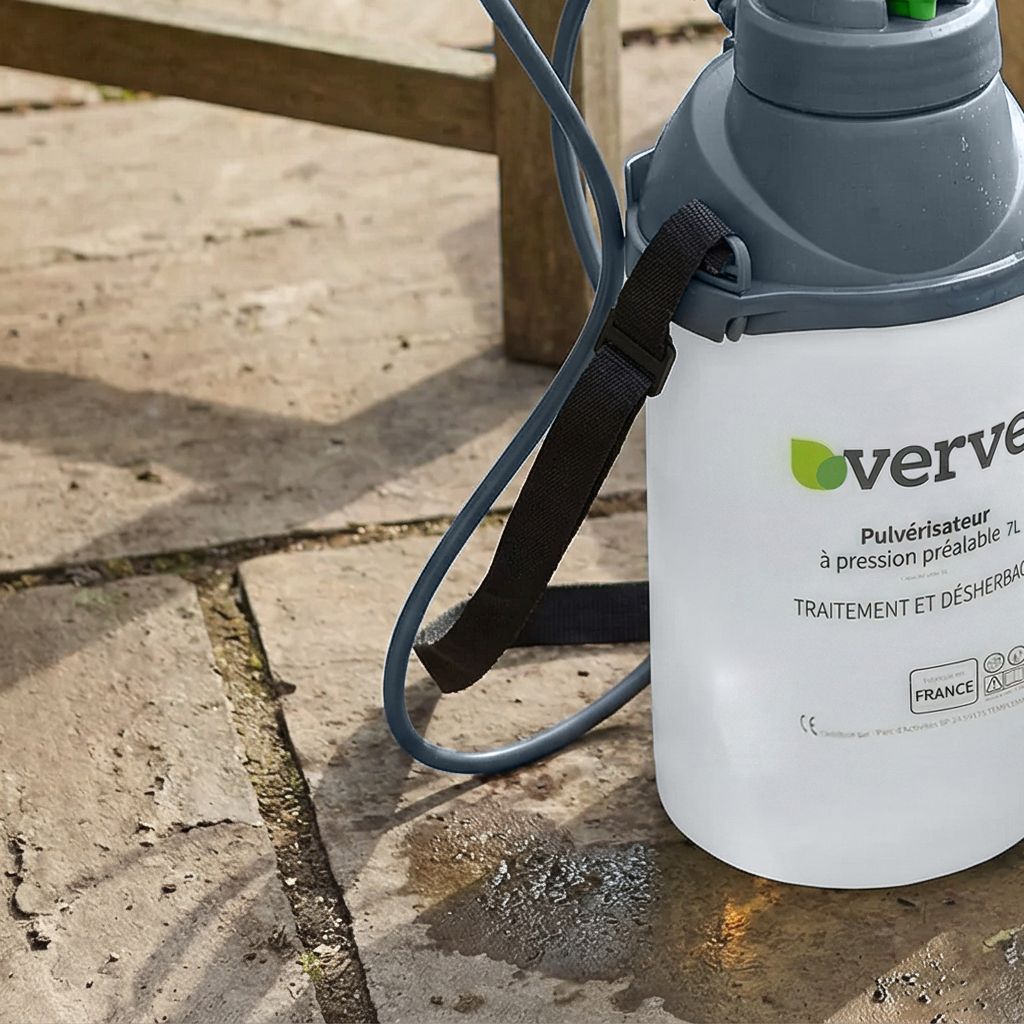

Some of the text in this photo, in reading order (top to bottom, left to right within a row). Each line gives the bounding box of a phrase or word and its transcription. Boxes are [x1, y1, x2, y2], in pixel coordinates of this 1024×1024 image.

[861, 508, 991, 545] Pulvérisateur
[819, 519, 1021, 573] à pression préalable 7L
[793, 597, 910, 620] TRAITEMENT
[914, 594, 936, 615] ET
[915, 679, 974, 702] FRANCE
